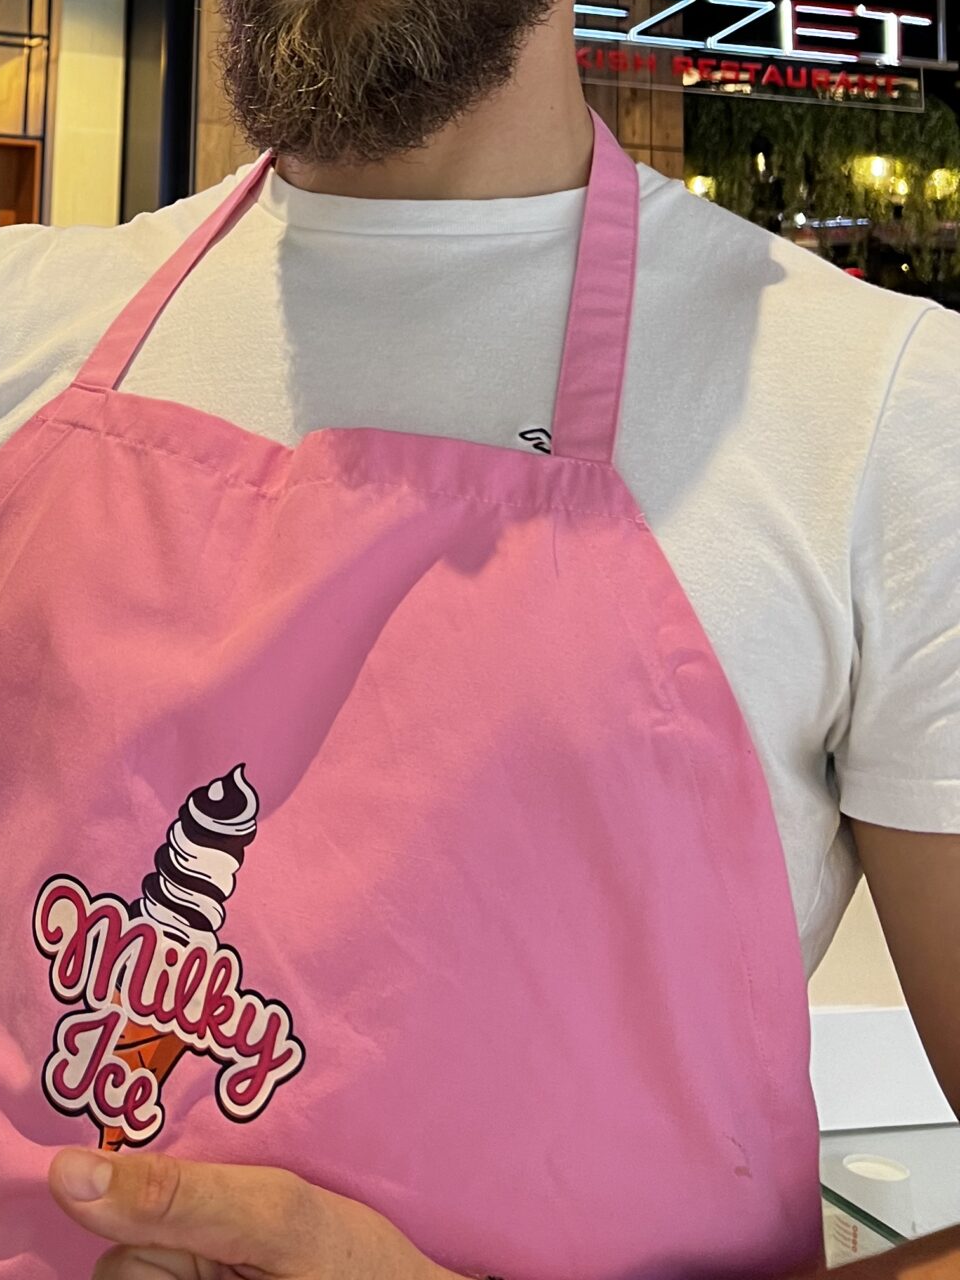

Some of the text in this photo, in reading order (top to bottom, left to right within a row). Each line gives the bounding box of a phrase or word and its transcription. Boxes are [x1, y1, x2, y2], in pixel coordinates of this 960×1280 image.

[575, 45, 901, 98] KISH RESTAURANT
[36, 881, 297, 1110] Milky
[50, 1009, 161, 1133] Ice
